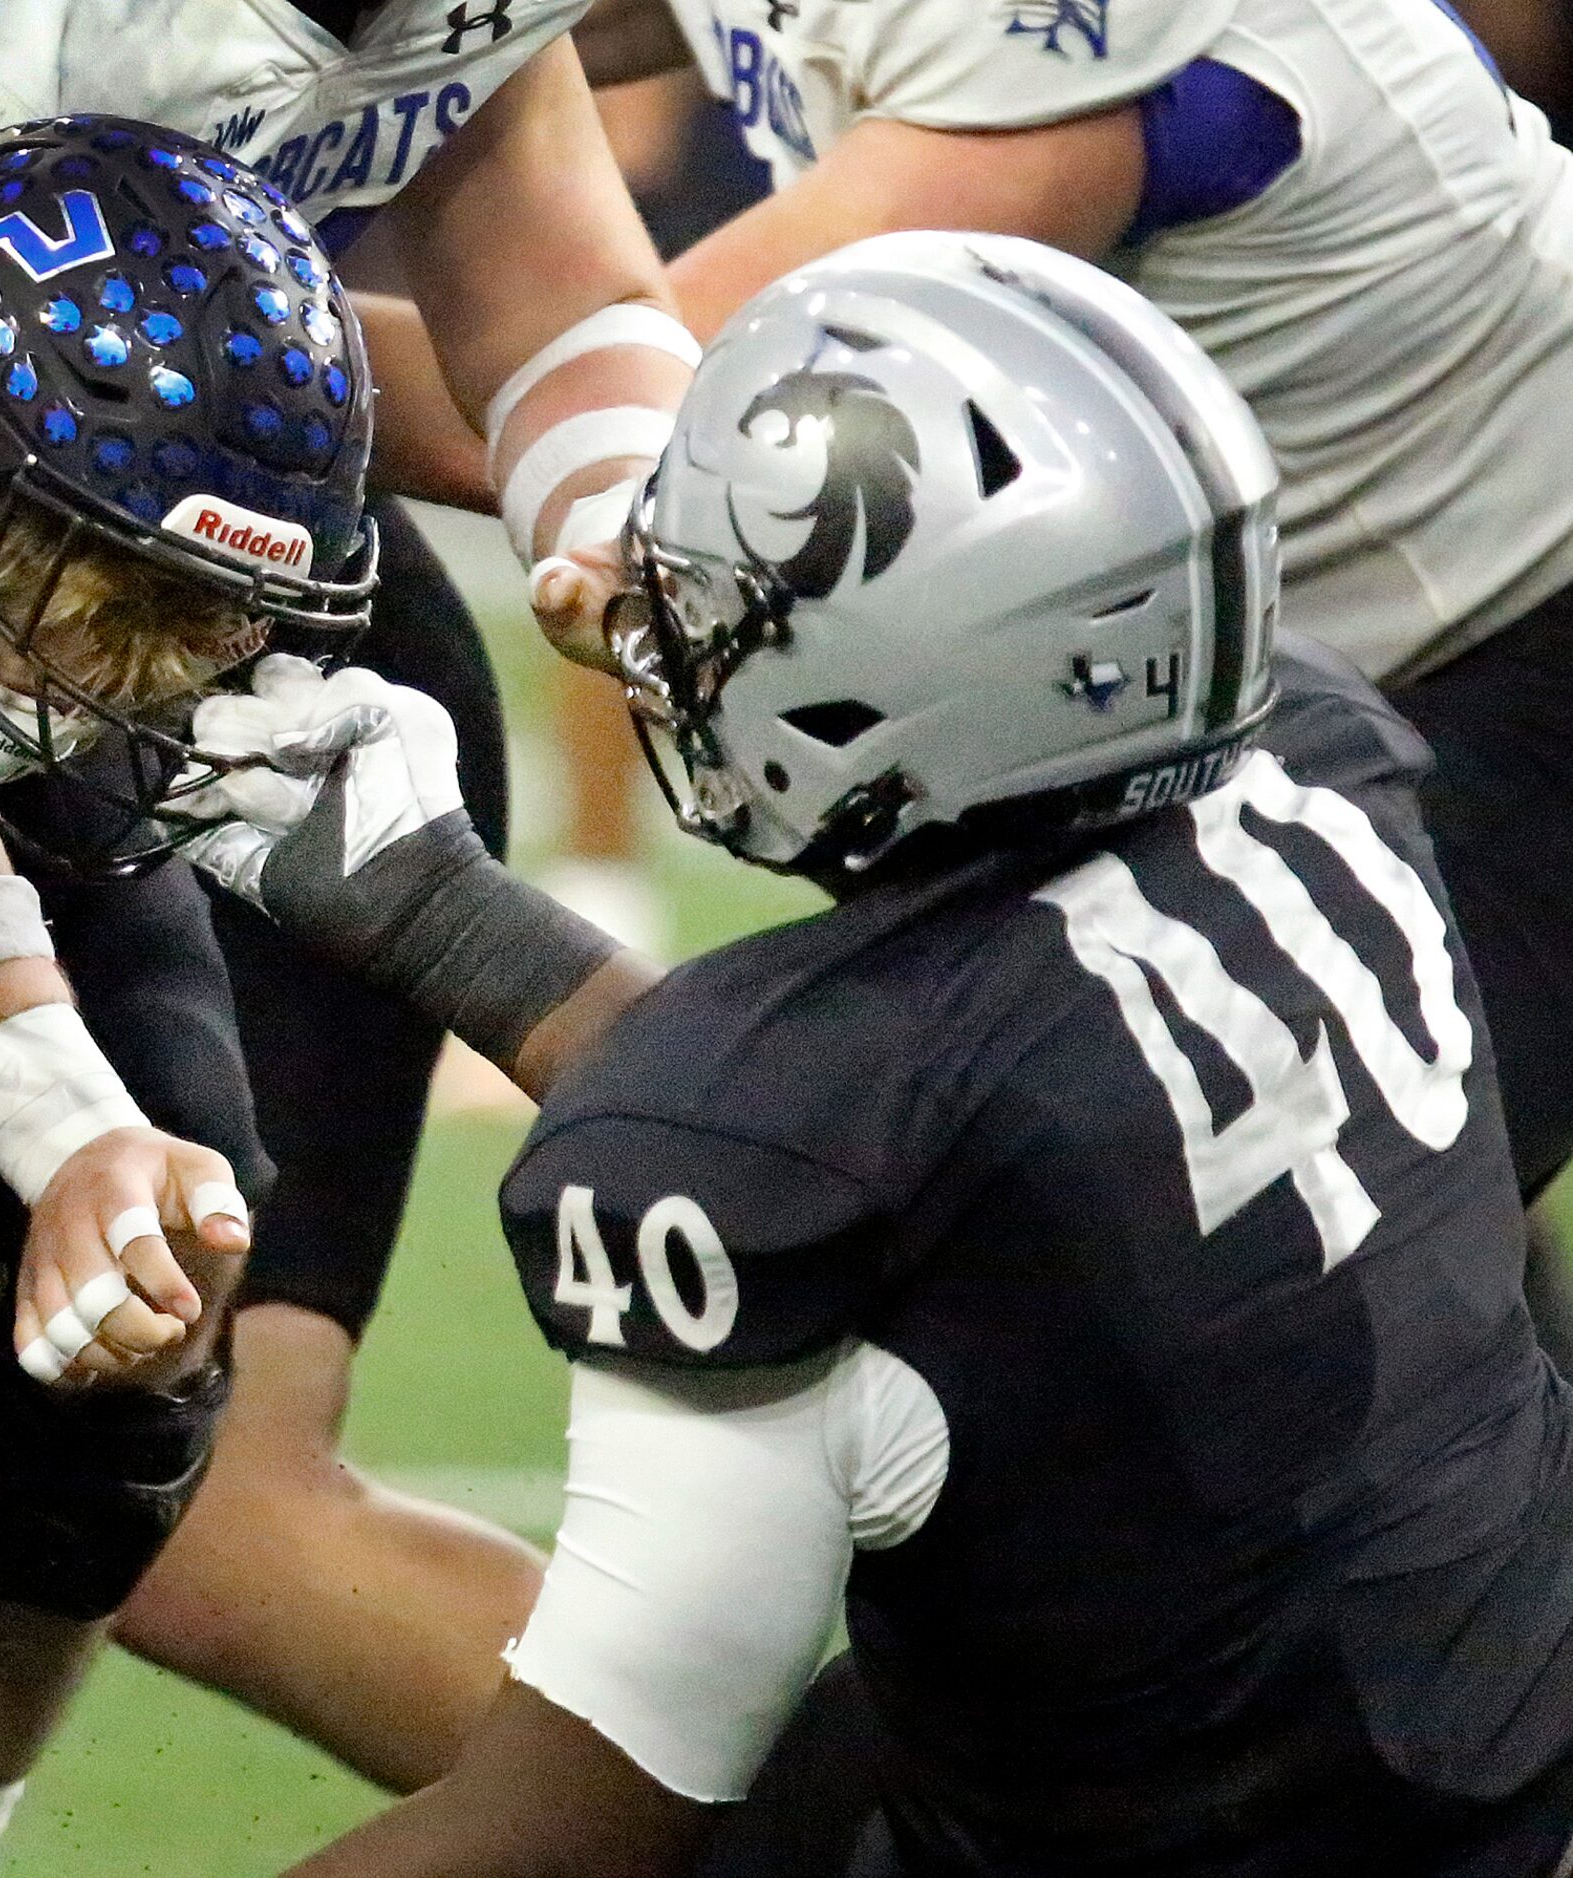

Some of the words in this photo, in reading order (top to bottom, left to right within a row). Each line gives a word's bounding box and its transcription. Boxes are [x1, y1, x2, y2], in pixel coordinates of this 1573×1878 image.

[192, 508, 308, 567] Riddell
[1030, 747, 1473, 1277] 40
[553, 1184, 741, 1354] 40
